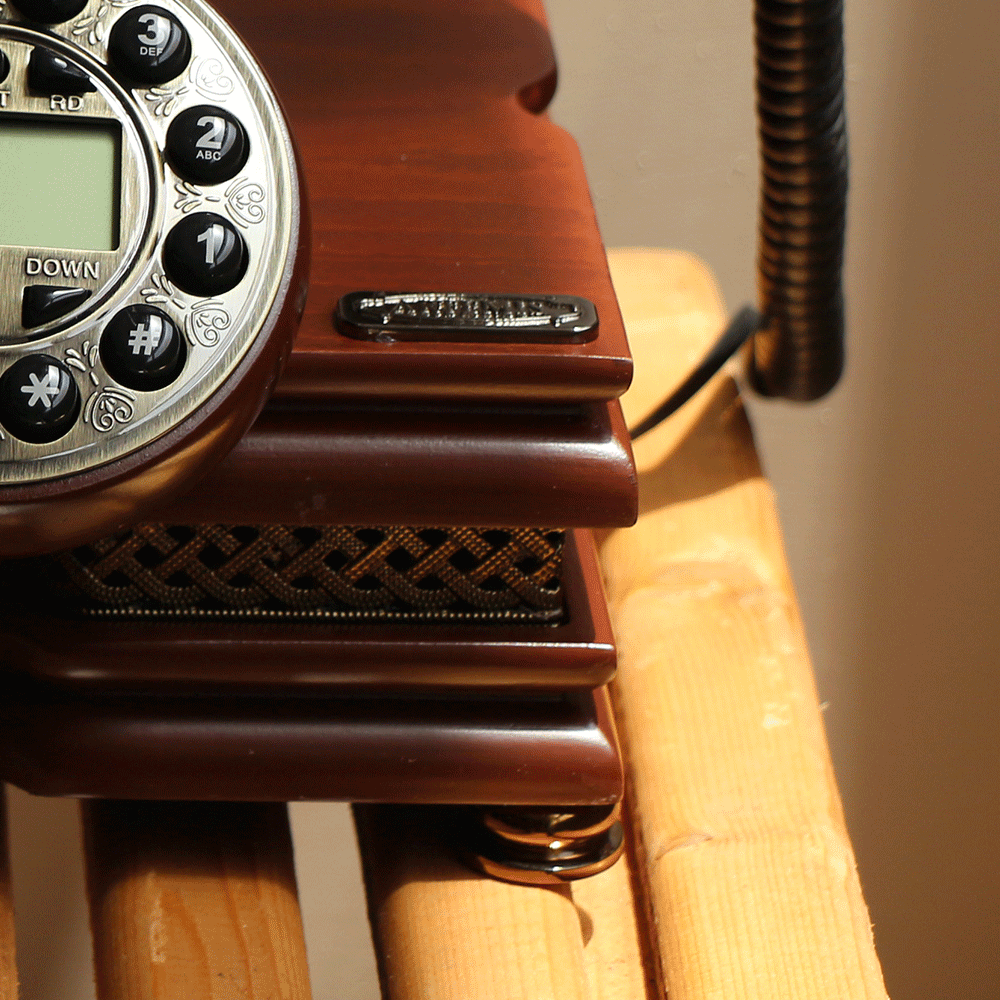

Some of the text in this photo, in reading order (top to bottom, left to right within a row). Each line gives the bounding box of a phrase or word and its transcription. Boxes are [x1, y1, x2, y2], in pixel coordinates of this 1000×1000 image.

[138, 13, 165, 46] 3
[140, 47, 163, 57] DEF
[49, 94, 85, 111] RD
[195, 116, 226, 150] 2
[196, 150, 222, 161] ABC
[197, 226, 217, 264] 1
[26, 257, 100, 279] DOWN
[128, 323, 160, 356] #
